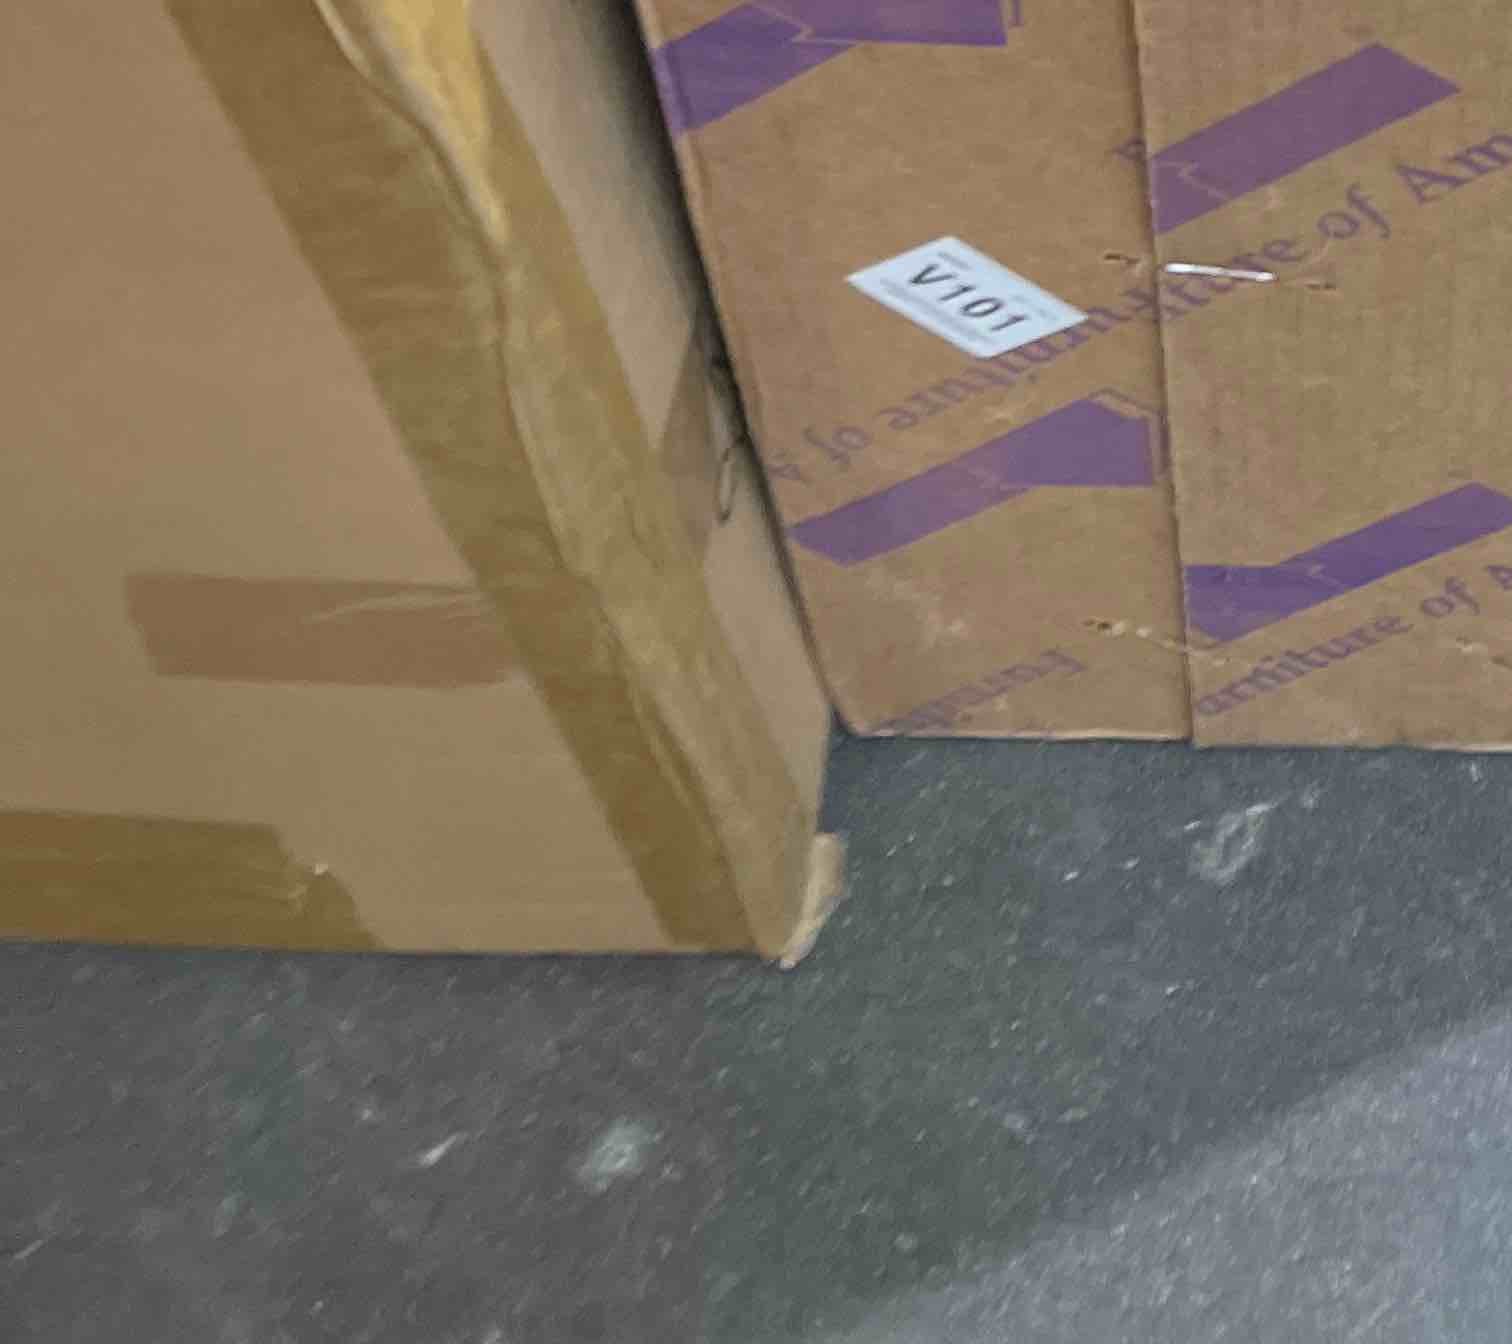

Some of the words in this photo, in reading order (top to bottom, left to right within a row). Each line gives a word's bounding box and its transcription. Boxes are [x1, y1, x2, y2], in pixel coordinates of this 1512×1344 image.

[1316, 181, 1393, 240] of
[910, 262, 1029, 333] V101
[1198, 612, 1414, 718] urniture
[1418, 574, 1481, 614] of
